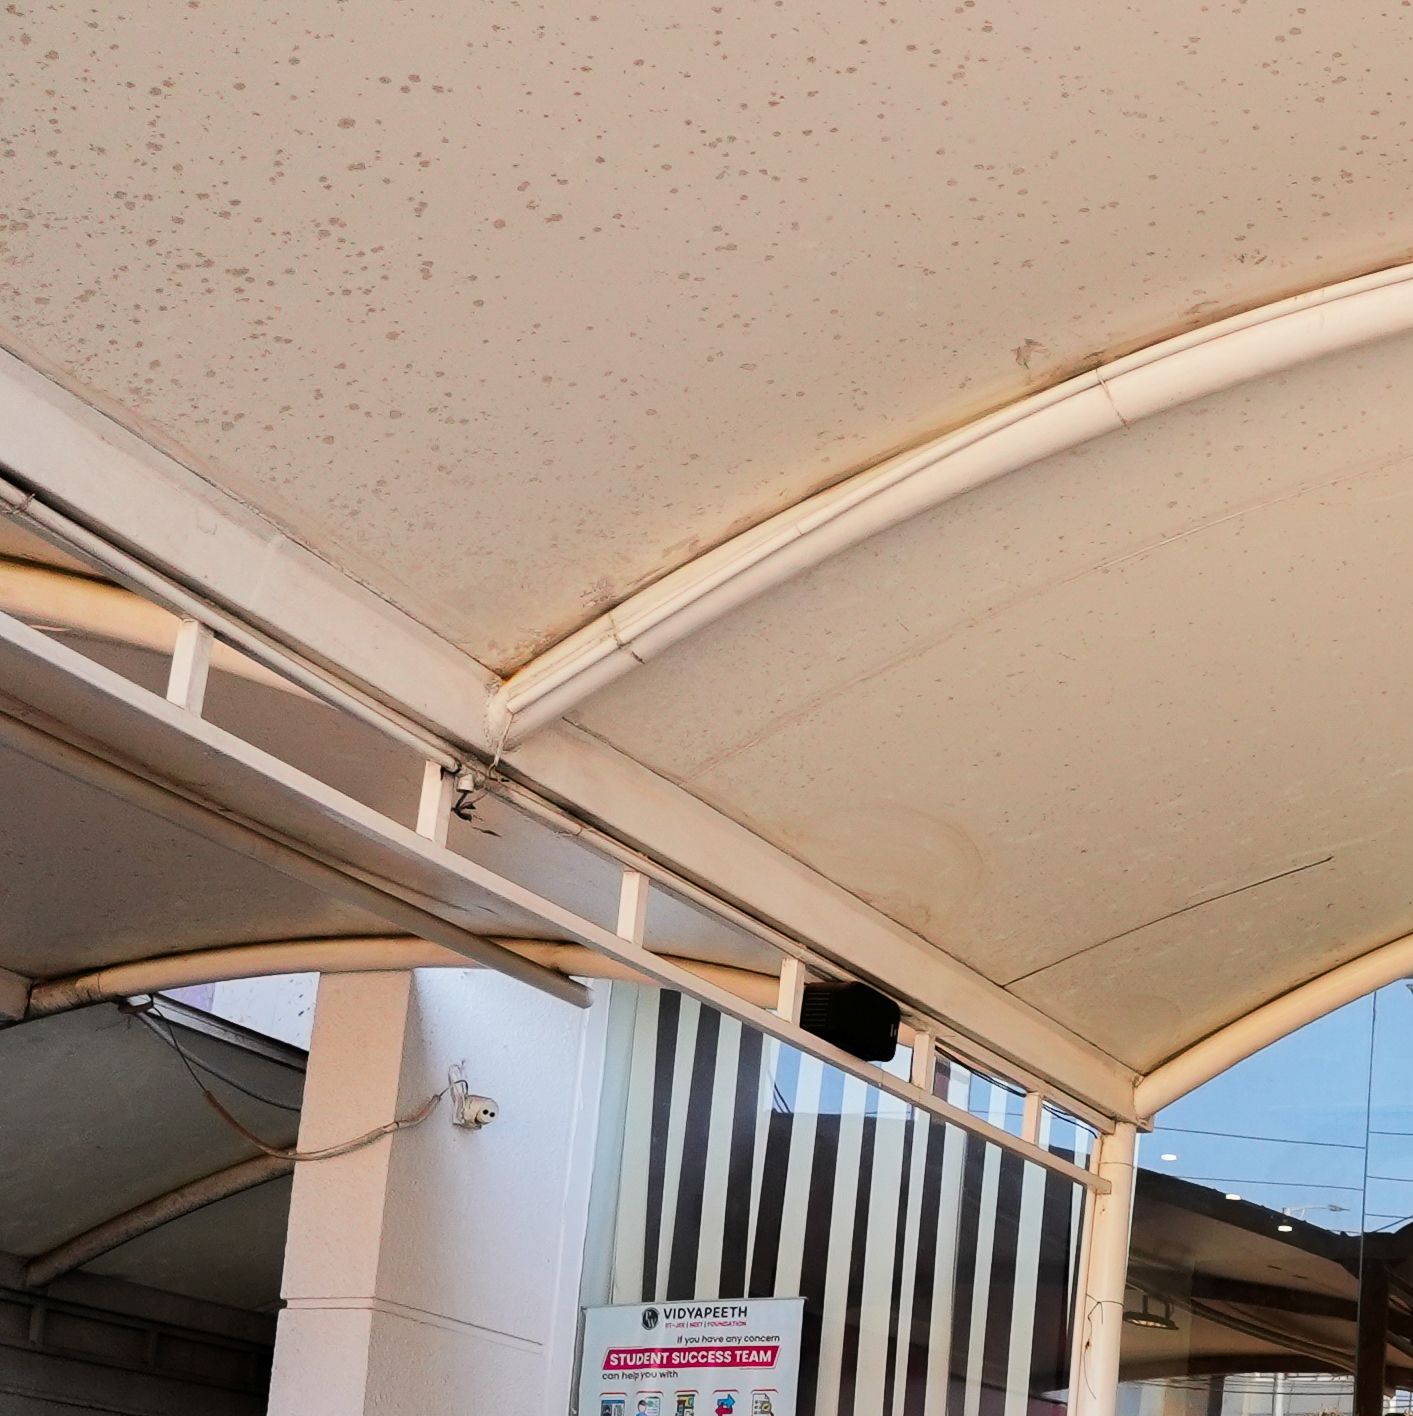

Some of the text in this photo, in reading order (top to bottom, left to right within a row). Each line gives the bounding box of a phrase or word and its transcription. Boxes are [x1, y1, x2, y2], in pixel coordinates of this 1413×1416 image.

[664, 1306, 748, 1319] VIDYAPEETH
[684, 1336, 700, 1346] you
[702, 1335, 723, 1343] have
[726, 1336, 742, 1346] any
[610, 1351, 771, 1366] STUDENT SUCCESS TEAM
[640, 1372, 657, 1380] you
[659, 1370, 678, 1378] with
